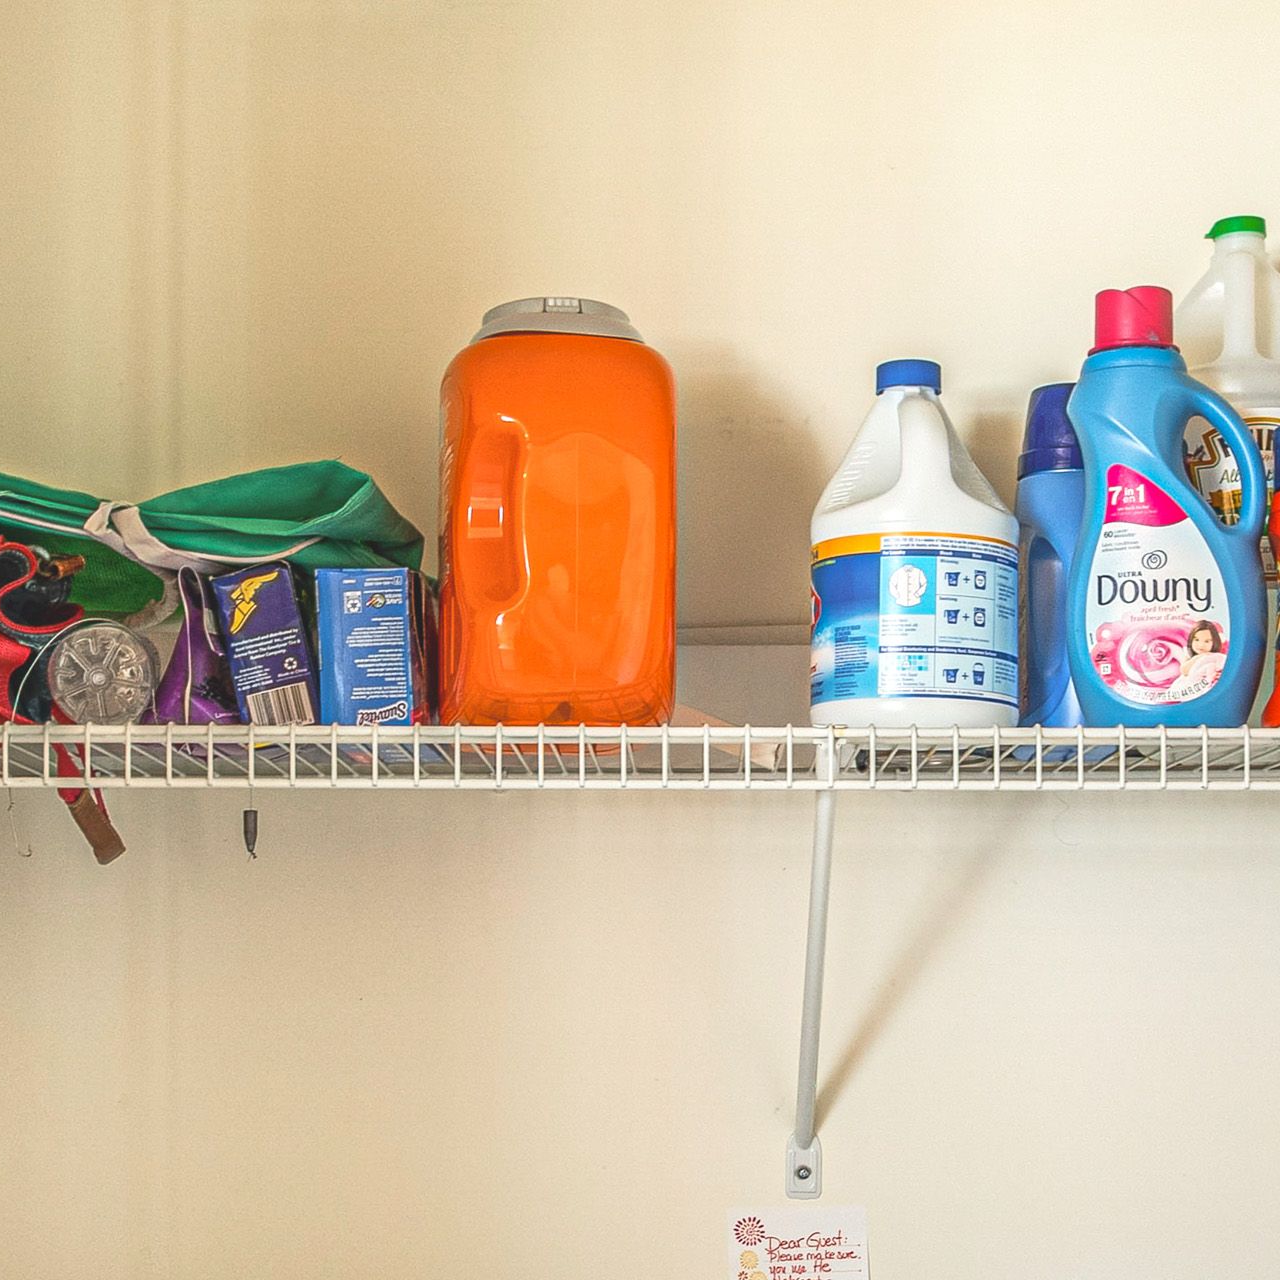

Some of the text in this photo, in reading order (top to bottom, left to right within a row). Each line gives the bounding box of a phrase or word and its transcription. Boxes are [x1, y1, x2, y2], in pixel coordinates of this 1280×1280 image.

[1108, 483, 1145, 506] 7 in 1
[1103, 530, 1114, 538] 60
[1117, 570, 1143, 578] ULTRA
[1096, 574, 1212, 613] Downy
[357, 701, 408, 728] Suavitel
[765, 1236, 805, 1253] Dear
[767, 1251, 804, 1263] Please
[806, 1250, 835, 1261] make
[769, 1265, 787, 1279] you
